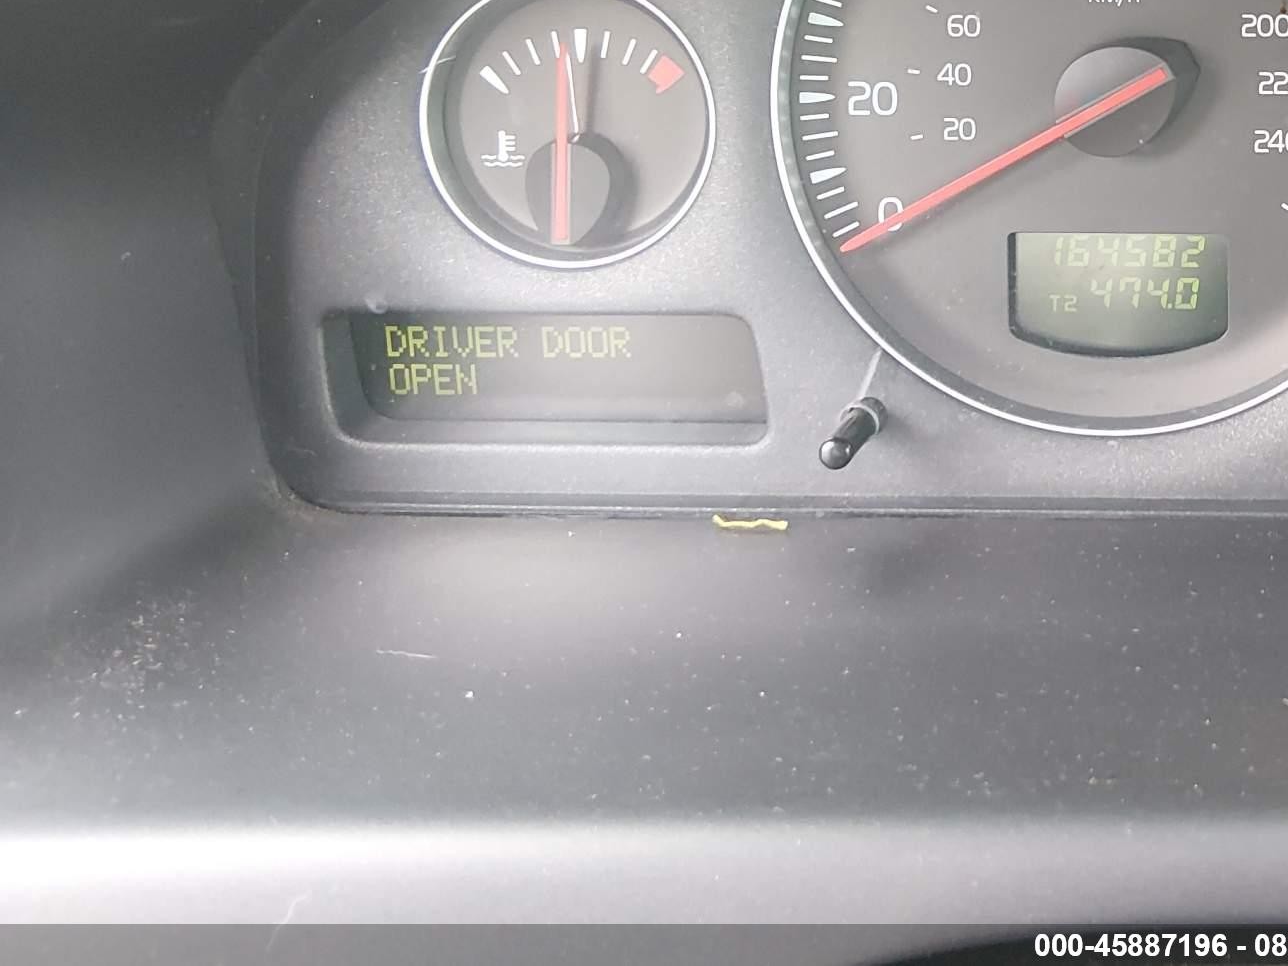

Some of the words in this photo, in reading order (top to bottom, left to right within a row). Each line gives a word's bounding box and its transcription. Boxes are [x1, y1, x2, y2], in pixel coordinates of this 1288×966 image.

[946, 14, 981, 37] 60
[937, 64, 972, 87] 40
[848, 81, 897, 117] 20
[943, 118, 977, 141] 20
[878, 196, 903, 232] 0
[1053, 235, 1206, 269] 164582
[1049, 294, 1077, 312] T2
[1090, 278, 1200, 310] 474.0
[385, 325, 518, 358] DRIVER
[542, 326, 632, 358] DOOR
[389, 363, 477, 395] OPEN
